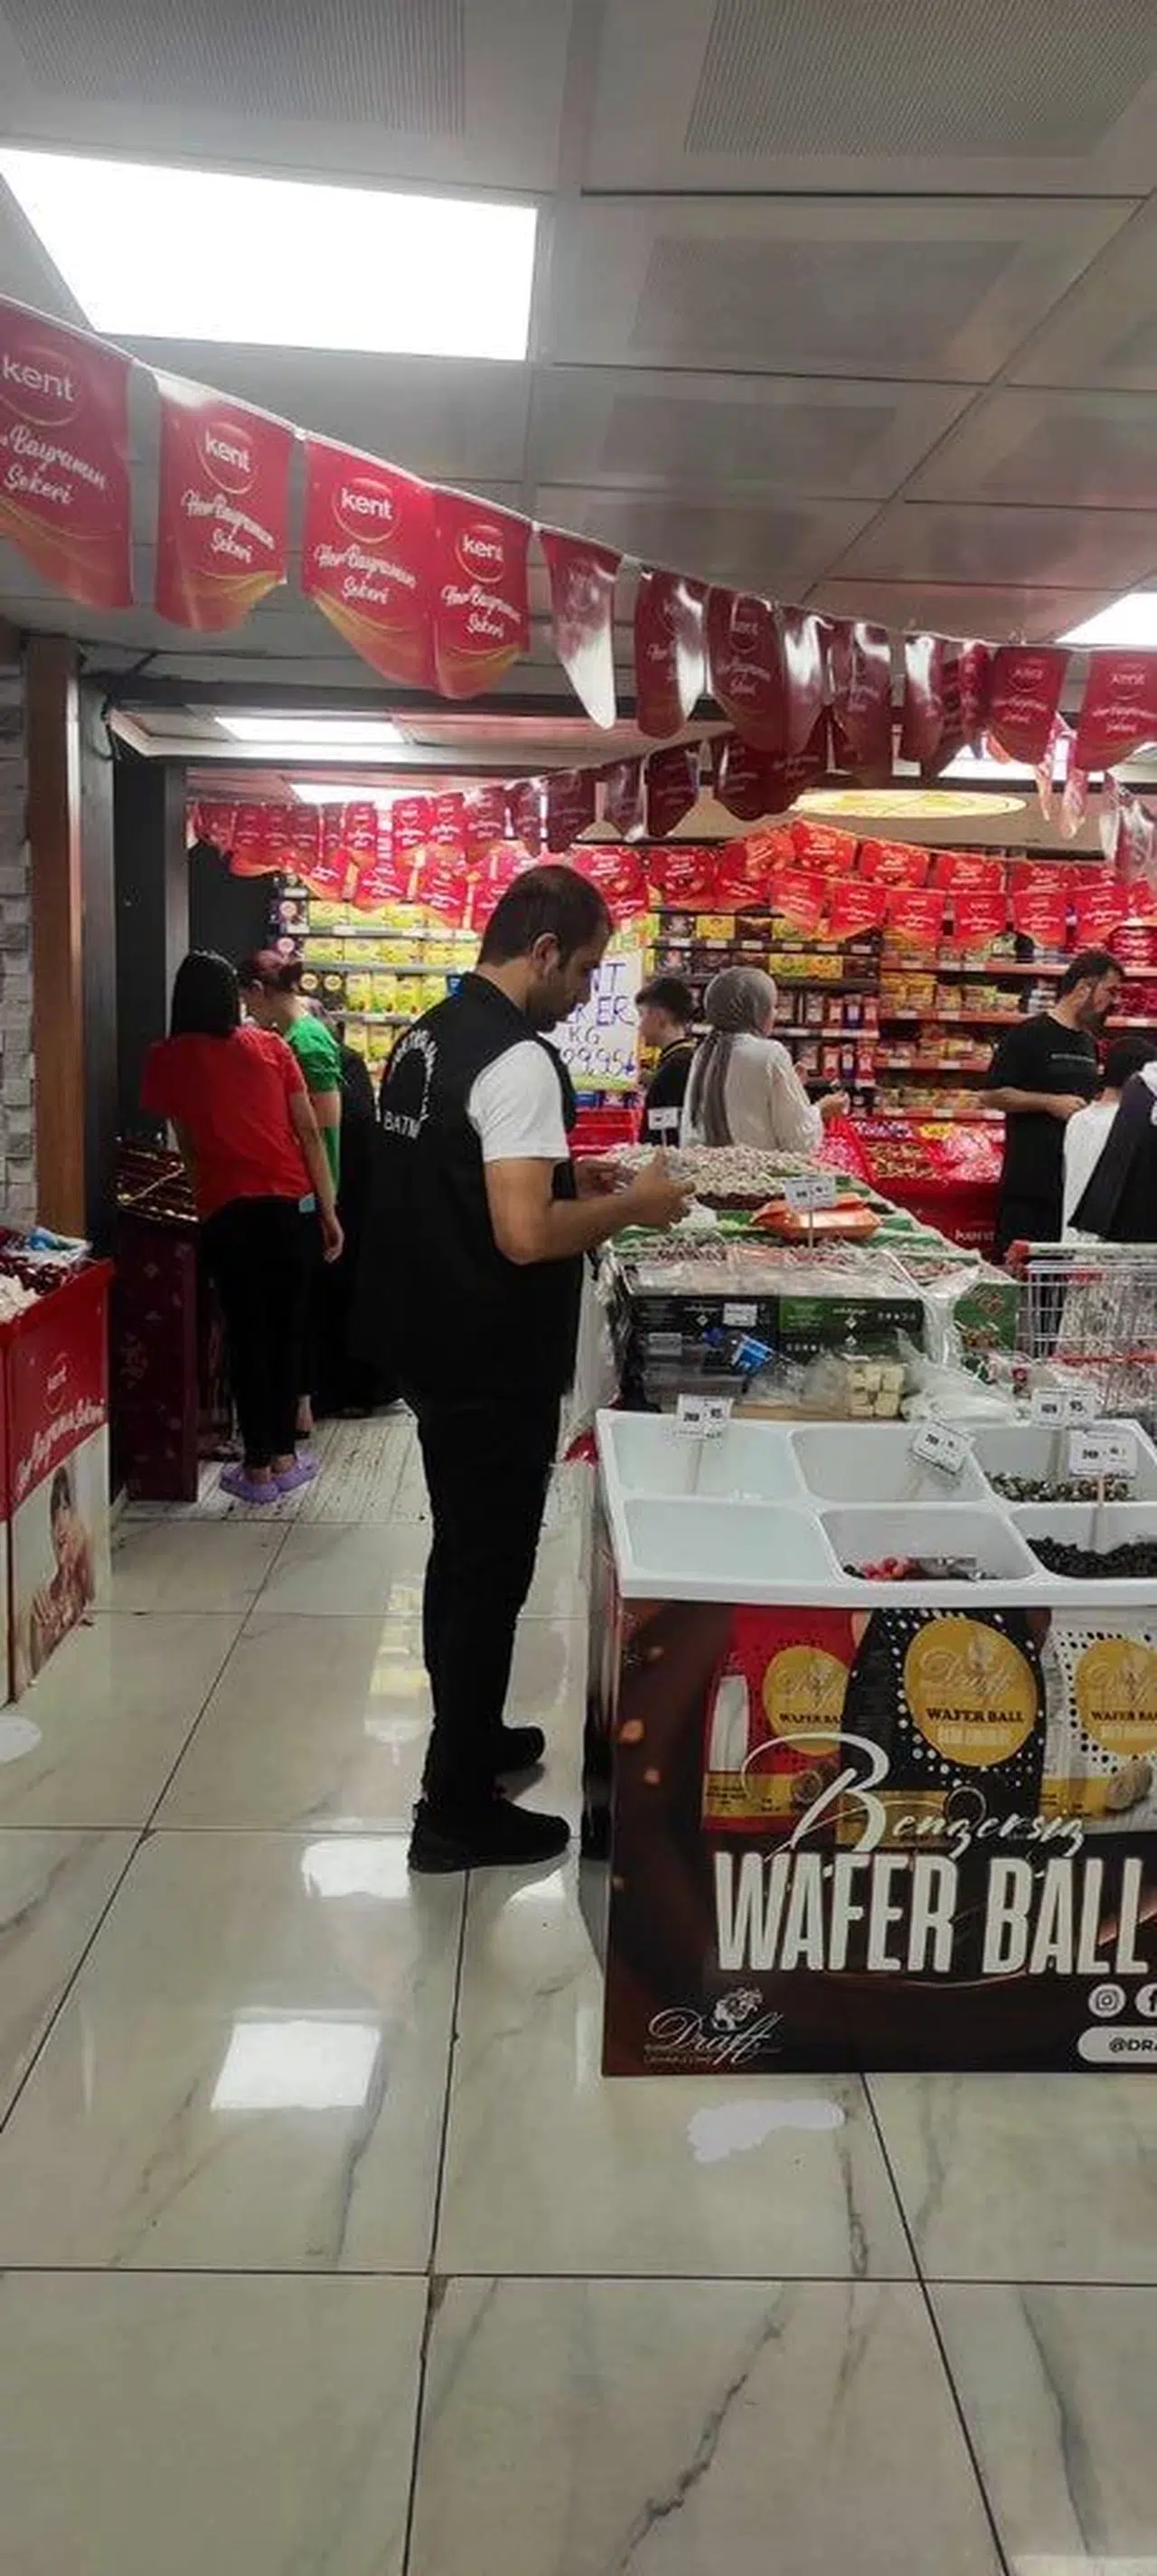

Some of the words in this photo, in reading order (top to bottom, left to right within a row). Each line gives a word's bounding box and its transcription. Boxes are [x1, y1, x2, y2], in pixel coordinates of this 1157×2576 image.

[2, 354, 75, 402] kent
[204, 428, 250, 473] kent
[340, 487, 393, 521] kent
[462, 534, 503, 562] kent
[714, 1851, 958, 1973] WAFER
[982, 1856, 1149, 1975] BALL
